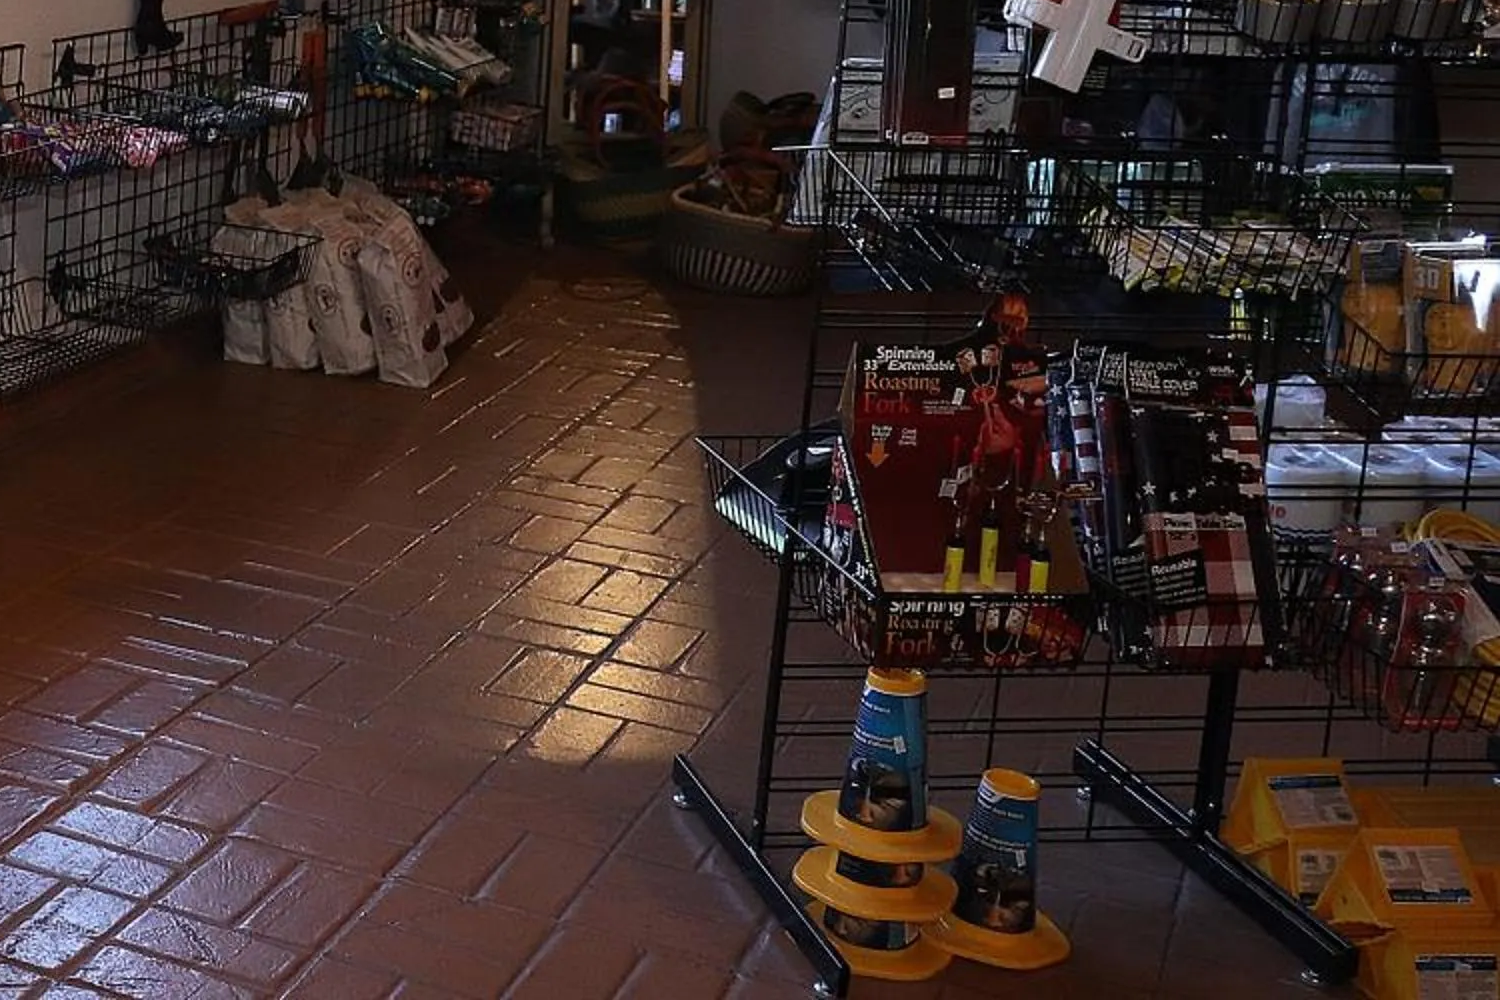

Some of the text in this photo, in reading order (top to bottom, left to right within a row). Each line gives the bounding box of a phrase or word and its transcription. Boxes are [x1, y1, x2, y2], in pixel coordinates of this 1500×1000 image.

[876, 345, 936, 362] Spinning
[864, 372, 941, 395] Roasting
[864, 391, 911, 414] Fork
